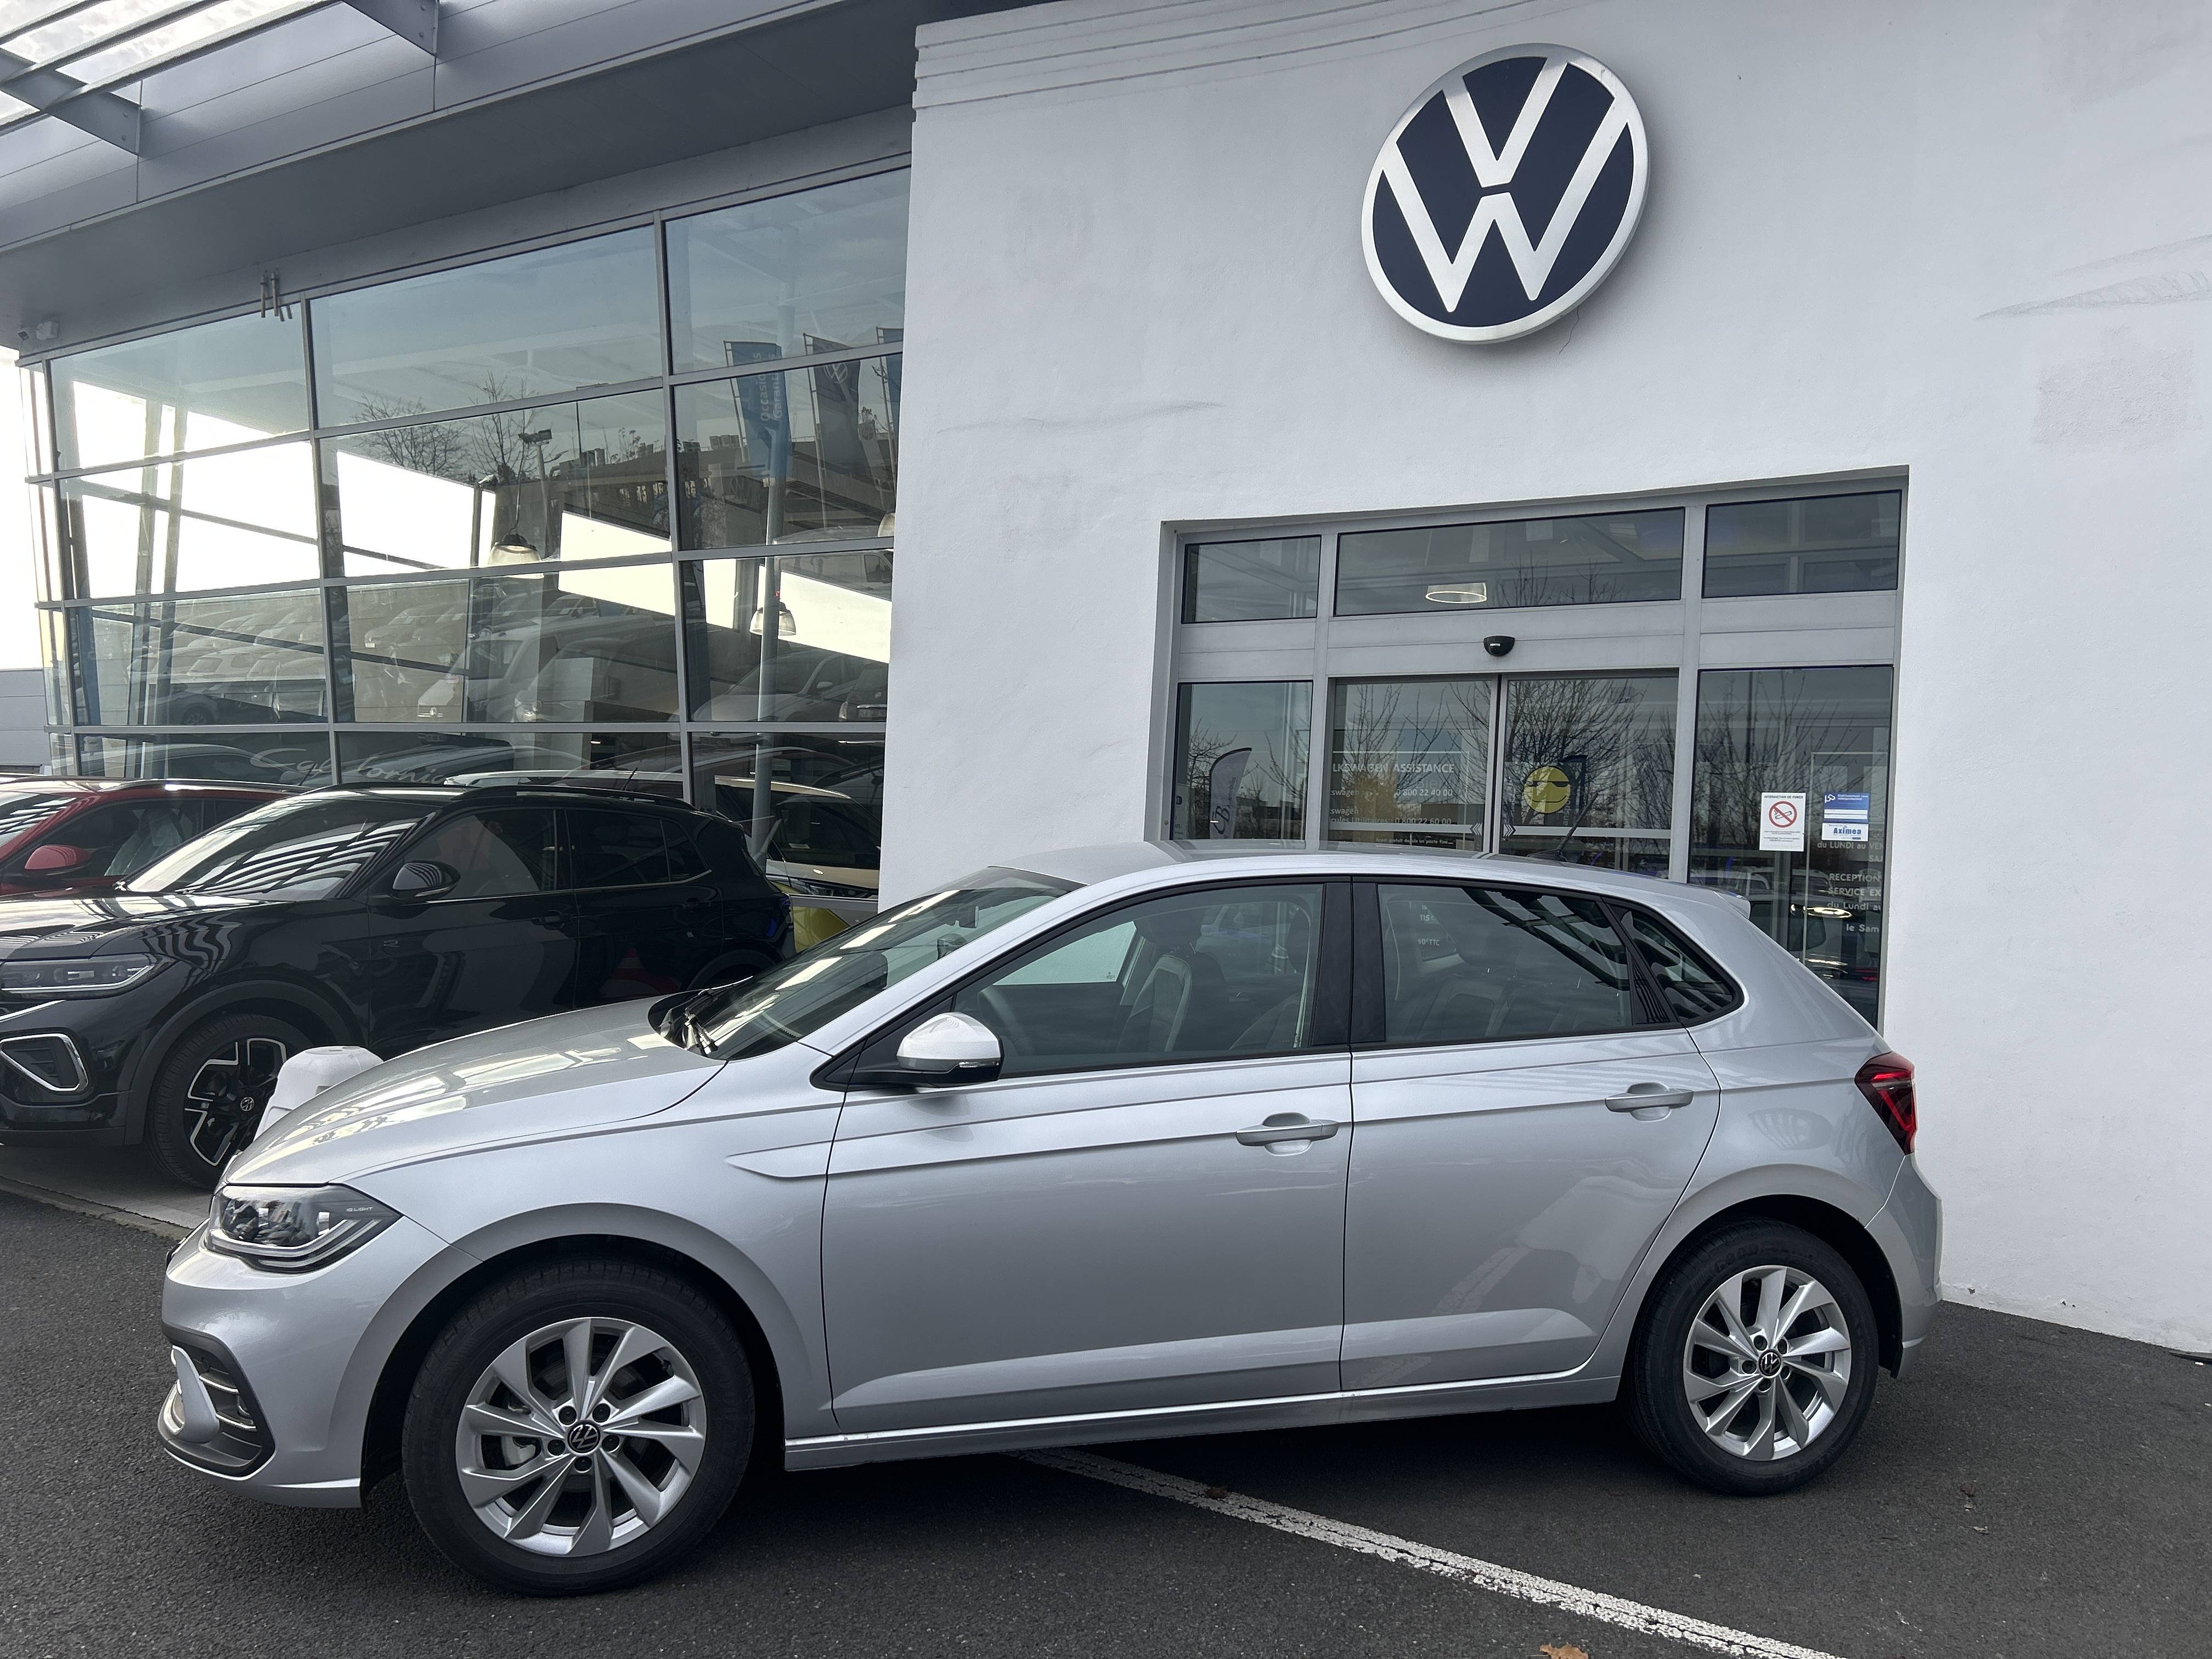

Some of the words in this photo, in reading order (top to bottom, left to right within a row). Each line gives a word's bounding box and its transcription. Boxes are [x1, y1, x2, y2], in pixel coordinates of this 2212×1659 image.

[1381, 56, 1629, 314] VW
[753, 352, 770, 421] Occasios
[1392, 763, 1455, 773] ASSISTANCE
[1330, 789, 1359, 797] swagen
[1329, 808, 1359, 816] swagen
[1829, 873, 1880, 882] RECEPTION
[1828, 888, 1865, 896] SERVICE
[1843, 902, 1869, 910] Lundi
